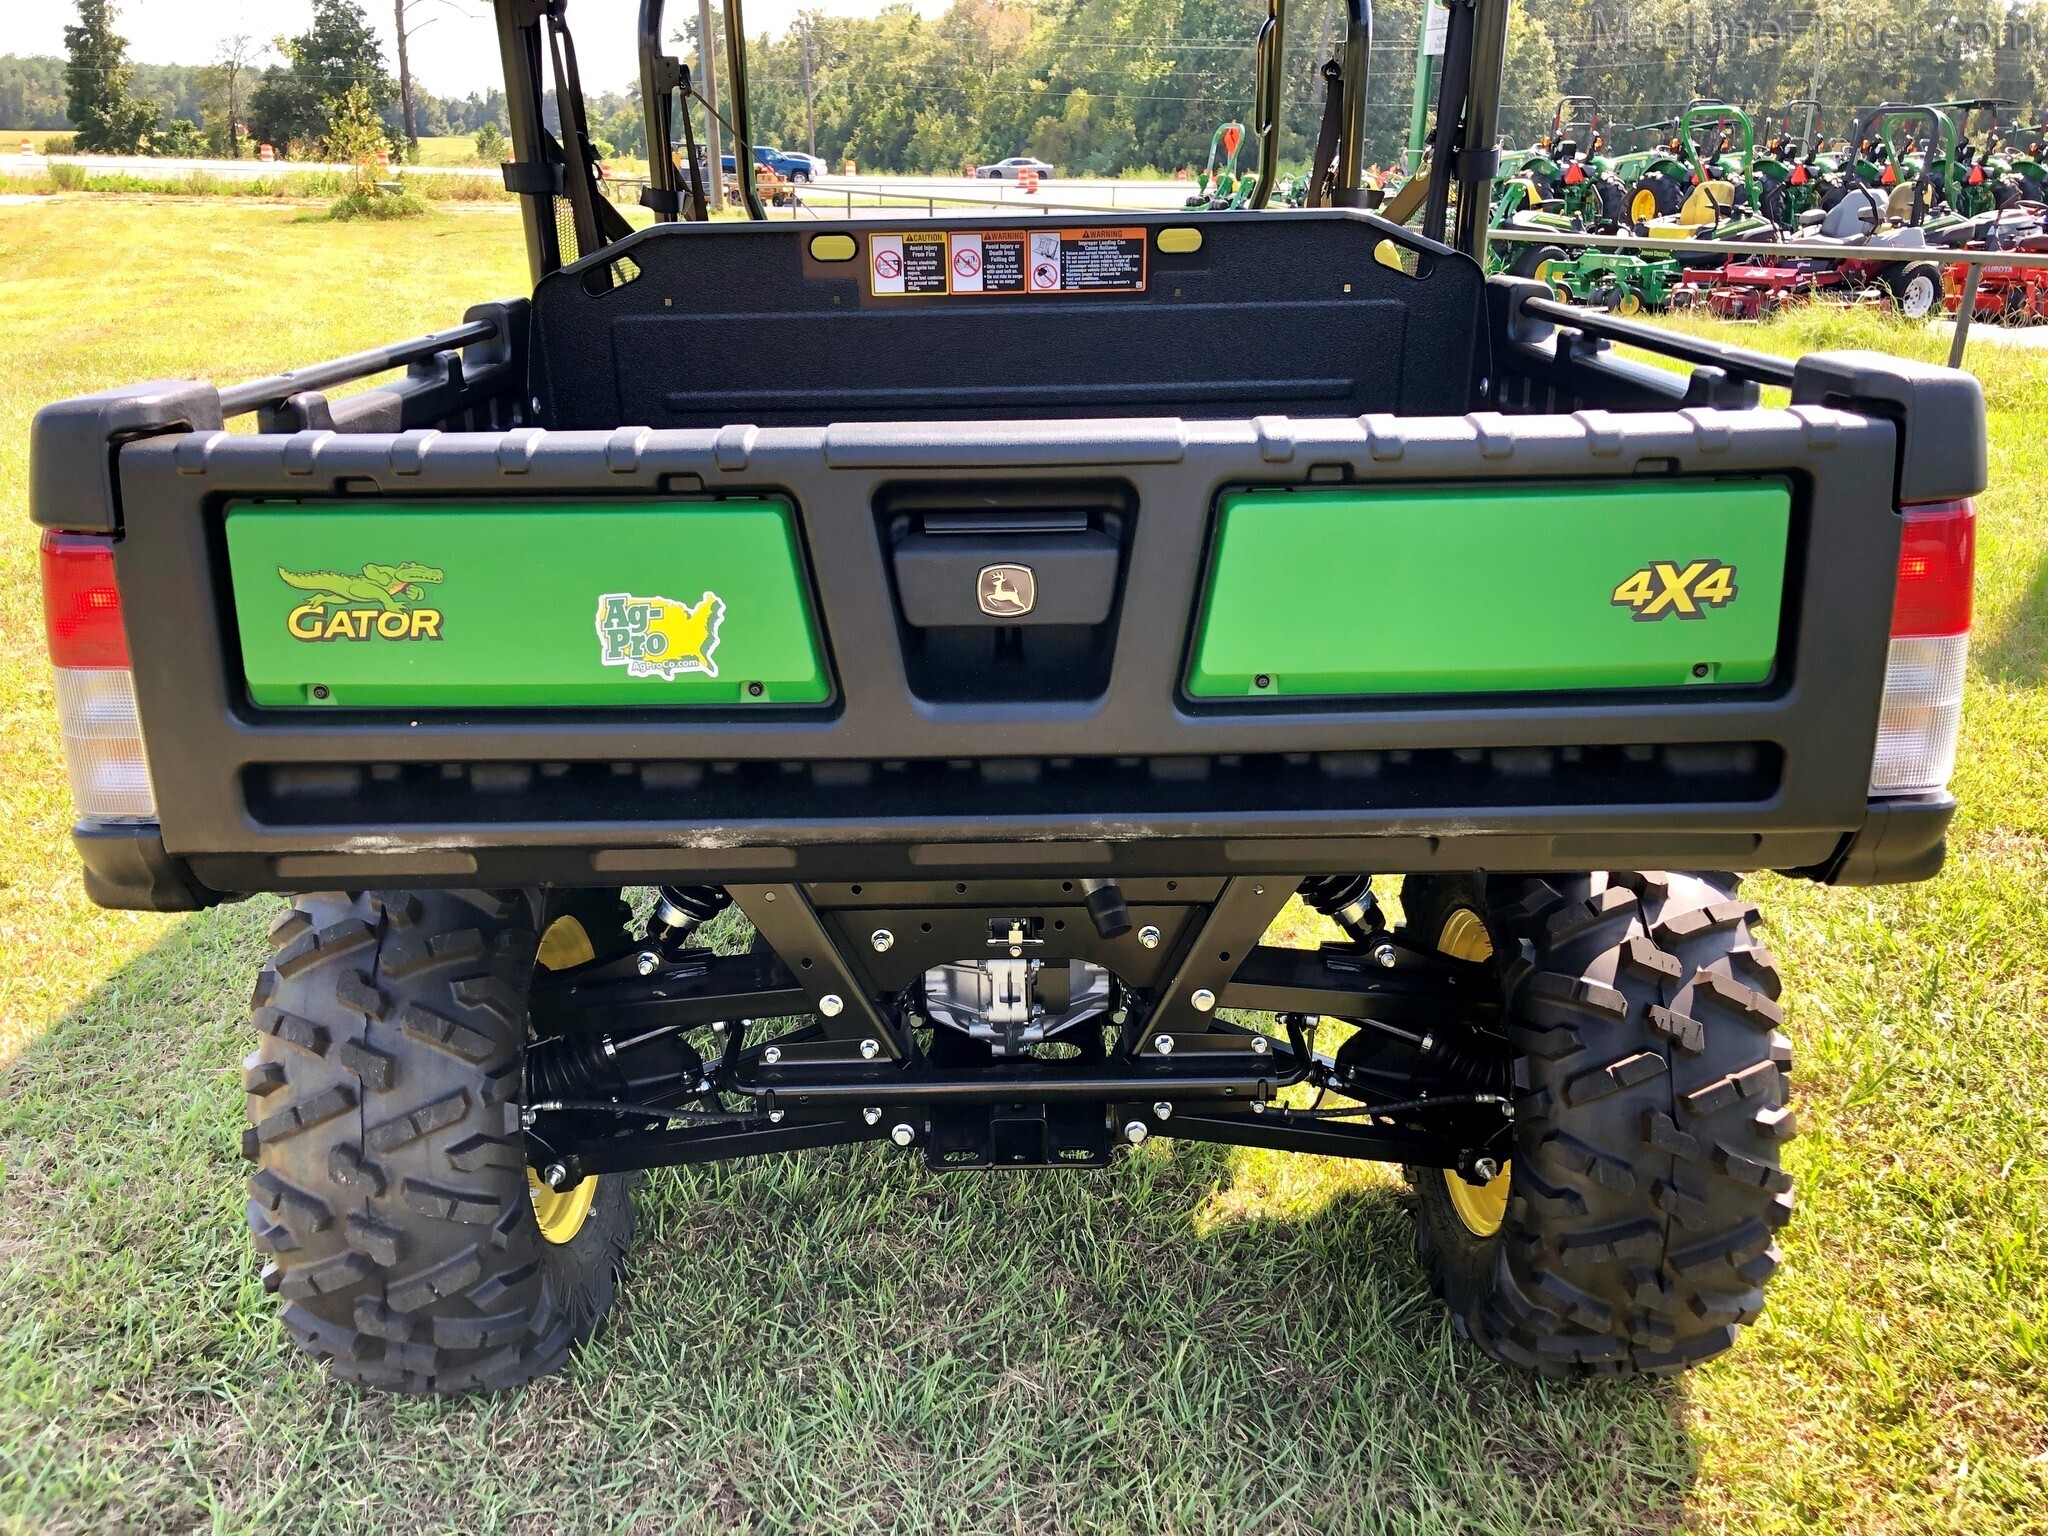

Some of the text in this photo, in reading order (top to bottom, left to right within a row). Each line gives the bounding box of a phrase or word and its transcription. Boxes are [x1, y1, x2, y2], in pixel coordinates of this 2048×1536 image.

[992, 232, 1024, 240] WARNING
[1982, 265, 2013, 273] KUBOTA
[1611, 559, 1739, 622] 4X4
[287, 604, 444, 643] GATOR
[604, 598, 662, 633] Ag-
[608, 628, 667, 658] Pro
[632, 659, 699, 672] AgProCo.com
